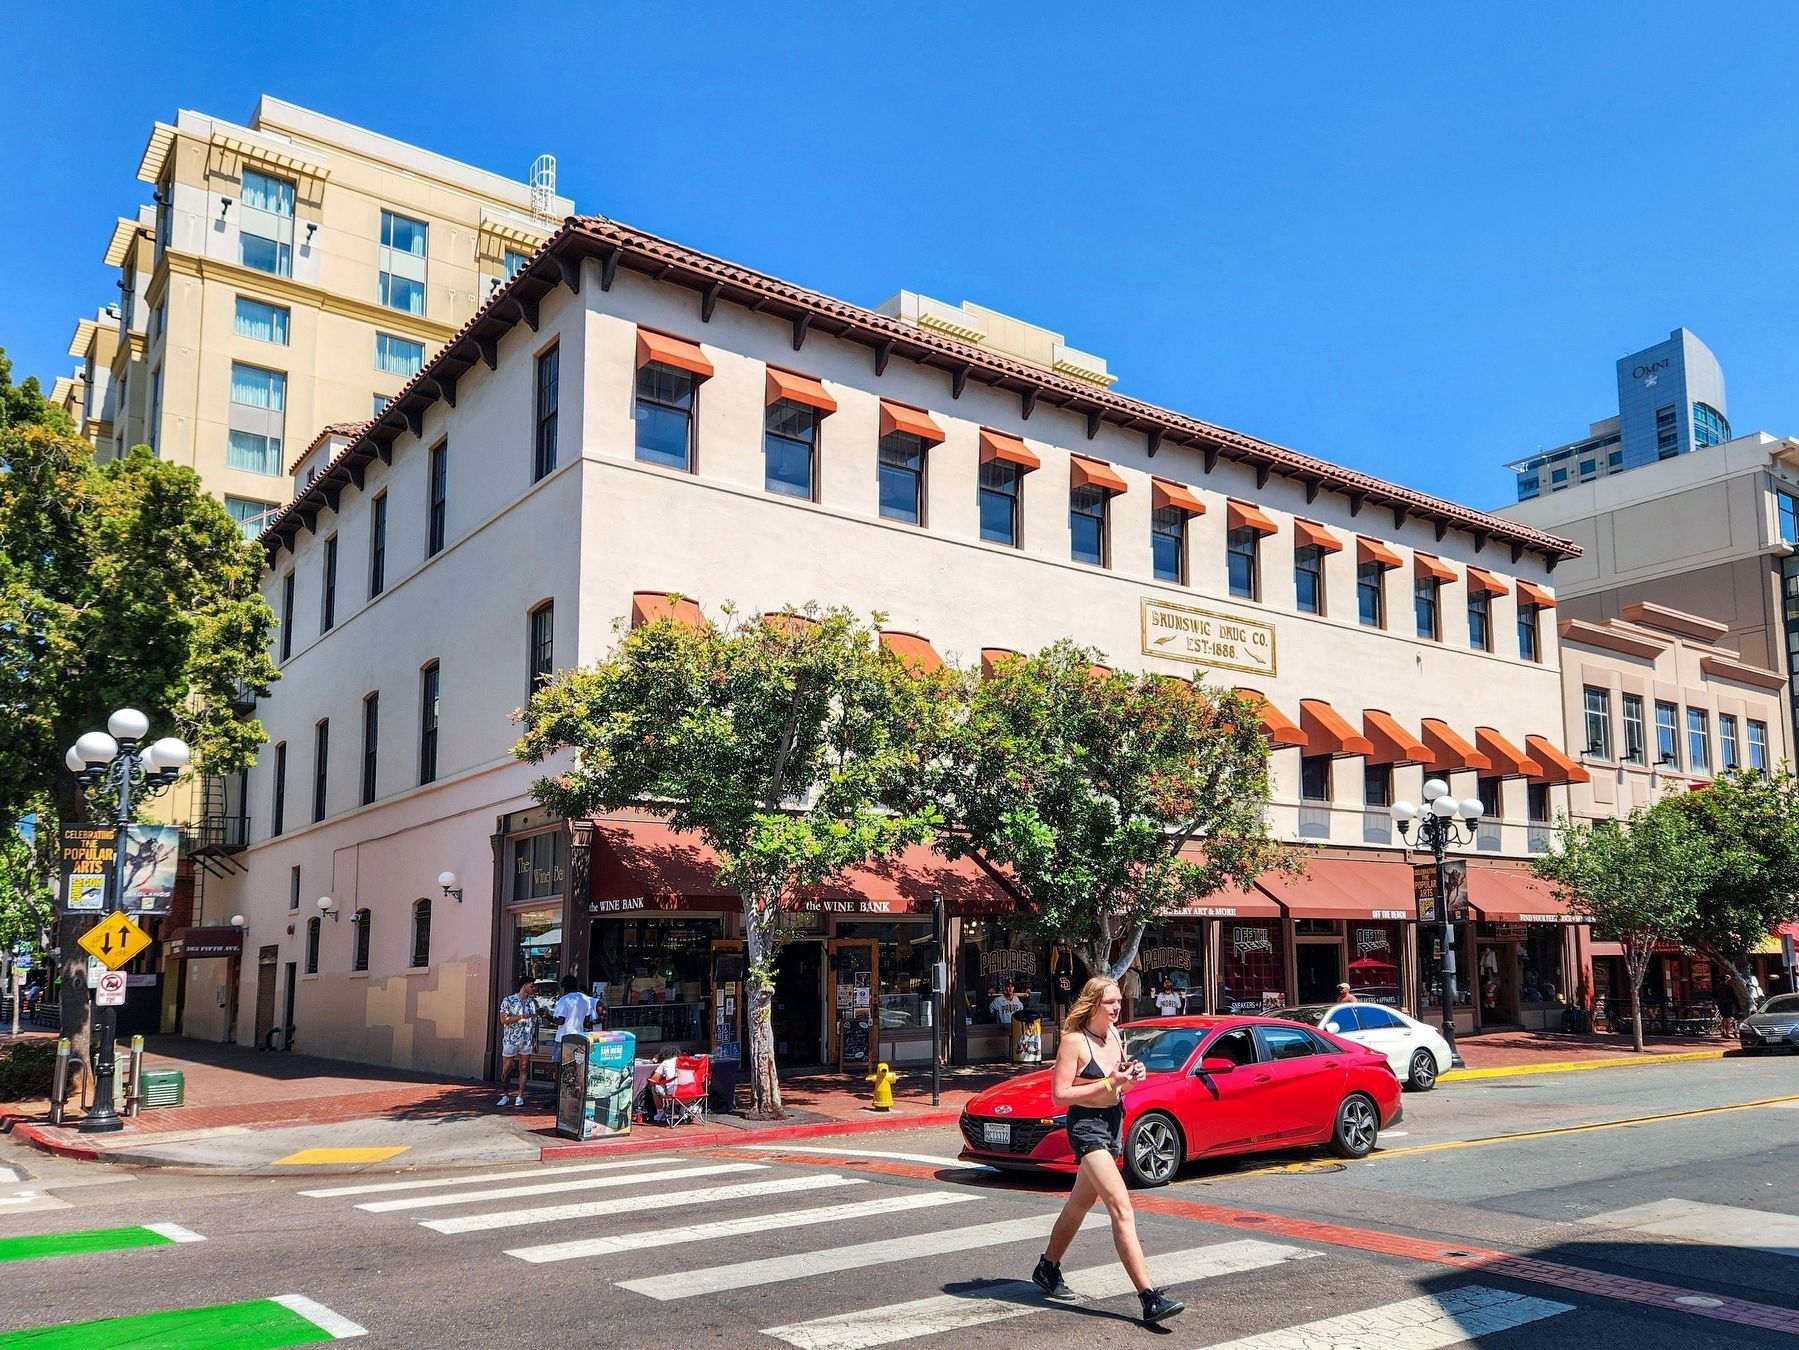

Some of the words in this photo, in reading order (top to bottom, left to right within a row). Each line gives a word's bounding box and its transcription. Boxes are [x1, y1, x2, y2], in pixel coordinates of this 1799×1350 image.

[1152, 610, 1211, 636] BRUNSWIG
[1219, 624, 1246, 643] DRUG
[1252, 631, 1268, 647] CO.
[64, 829, 115, 840] CELEBRATING
[81, 839, 99, 848] THE
[63, 847, 114, 861] POPULAR
[72, 860, 103, 873] ARTS
[517, 857, 530, 873] The
[82, 878, 103, 888] CON
[71, 878, 82, 903] COMIC
[1420, 888, 1434, 897] ARTS
[589, 902, 599, 912] the
[599, 900, 620, 912] WINE
[622, 897, 644, 910] BANK
[806, 901, 821, 911] the
[823, 901, 855, 912] WINE
[860, 901, 890, 912] BANK
[1193, 907, 1208, 915] ART
[1215, 907, 1236, 916] MORE
[1372, 910, 1382, 919] OFF
[1382, 910, 1391, 919] THE
[1233, 927, 1253, 944] OFF
[1253, 928, 1268, 942] THE
[1356, 929, 1374, 944] OFF
[980, 948, 1036, 976] PADRES
[1143, 947, 1191, 972] PADRES
[1231, 1001, 1255, 1009] SNEAKERS
